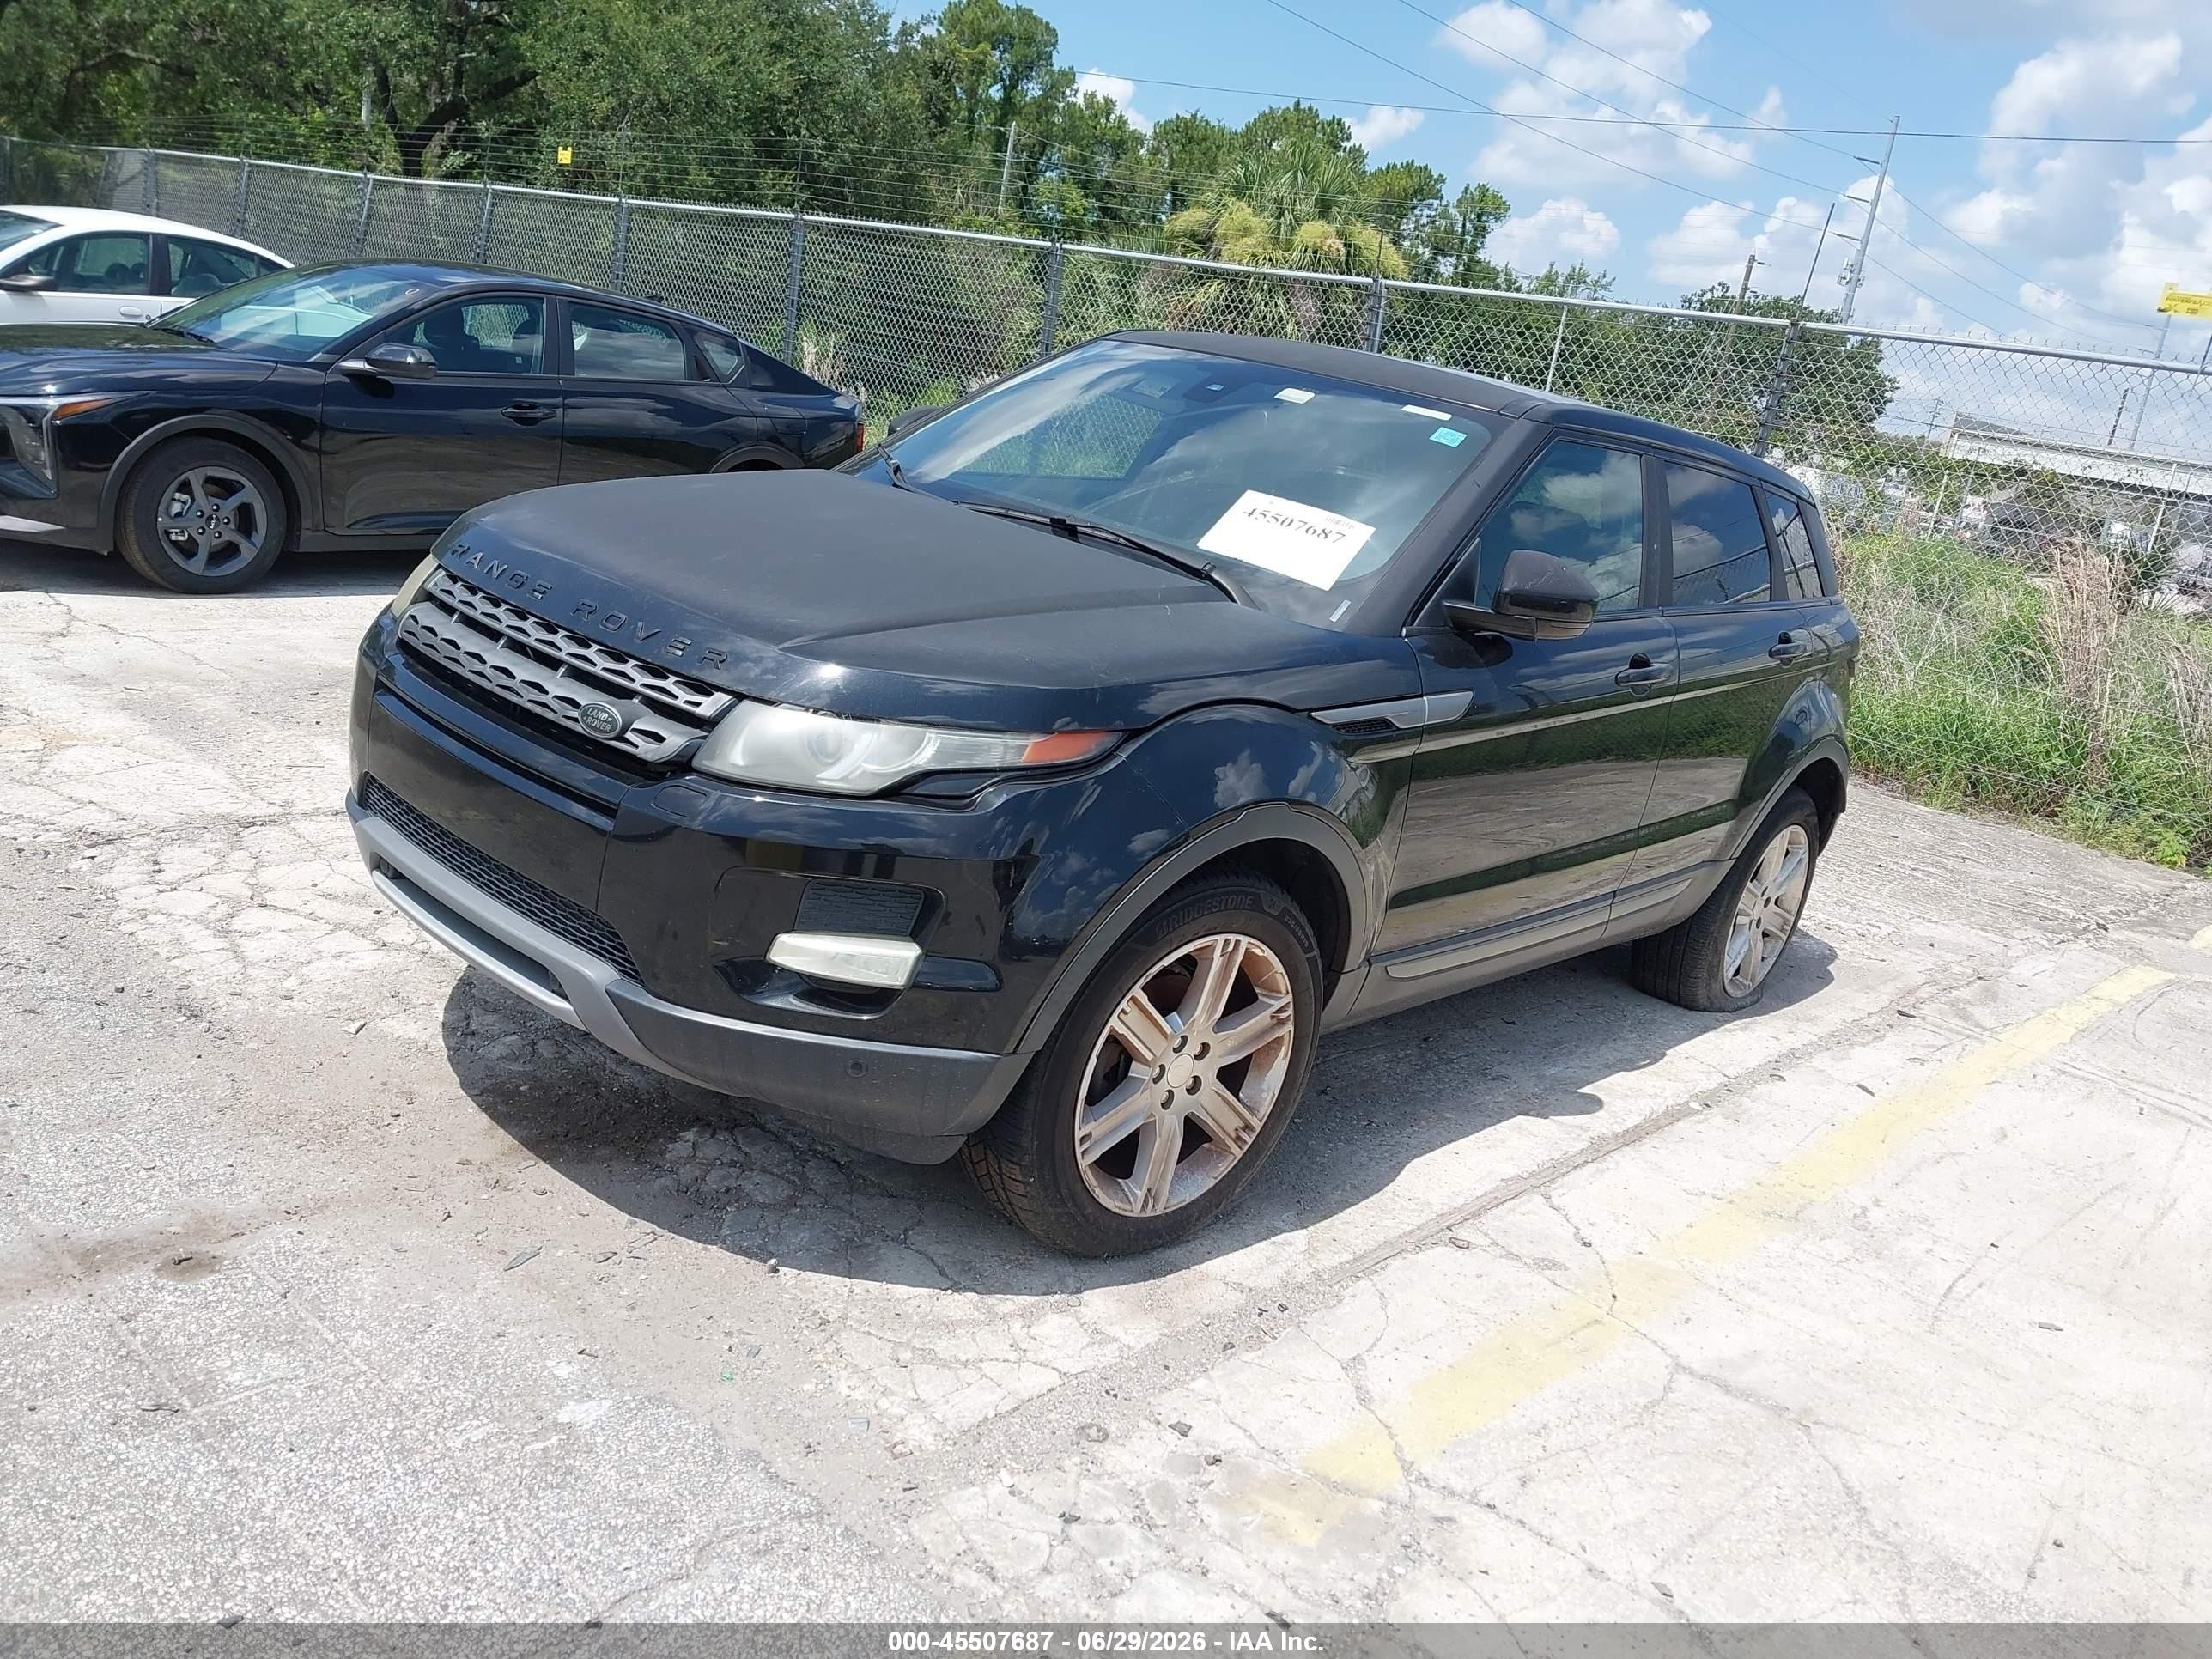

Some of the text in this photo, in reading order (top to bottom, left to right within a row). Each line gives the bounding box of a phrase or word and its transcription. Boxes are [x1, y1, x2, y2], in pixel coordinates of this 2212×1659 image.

[1243, 507, 1346, 544] 45507687
[449, 542, 728, 671] RANGE ROVER
[586, 707, 609, 721] LAND
[586, 716, 612, 732] ROVER
[1156, 895, 1254, 936] BRIDGESTONE
